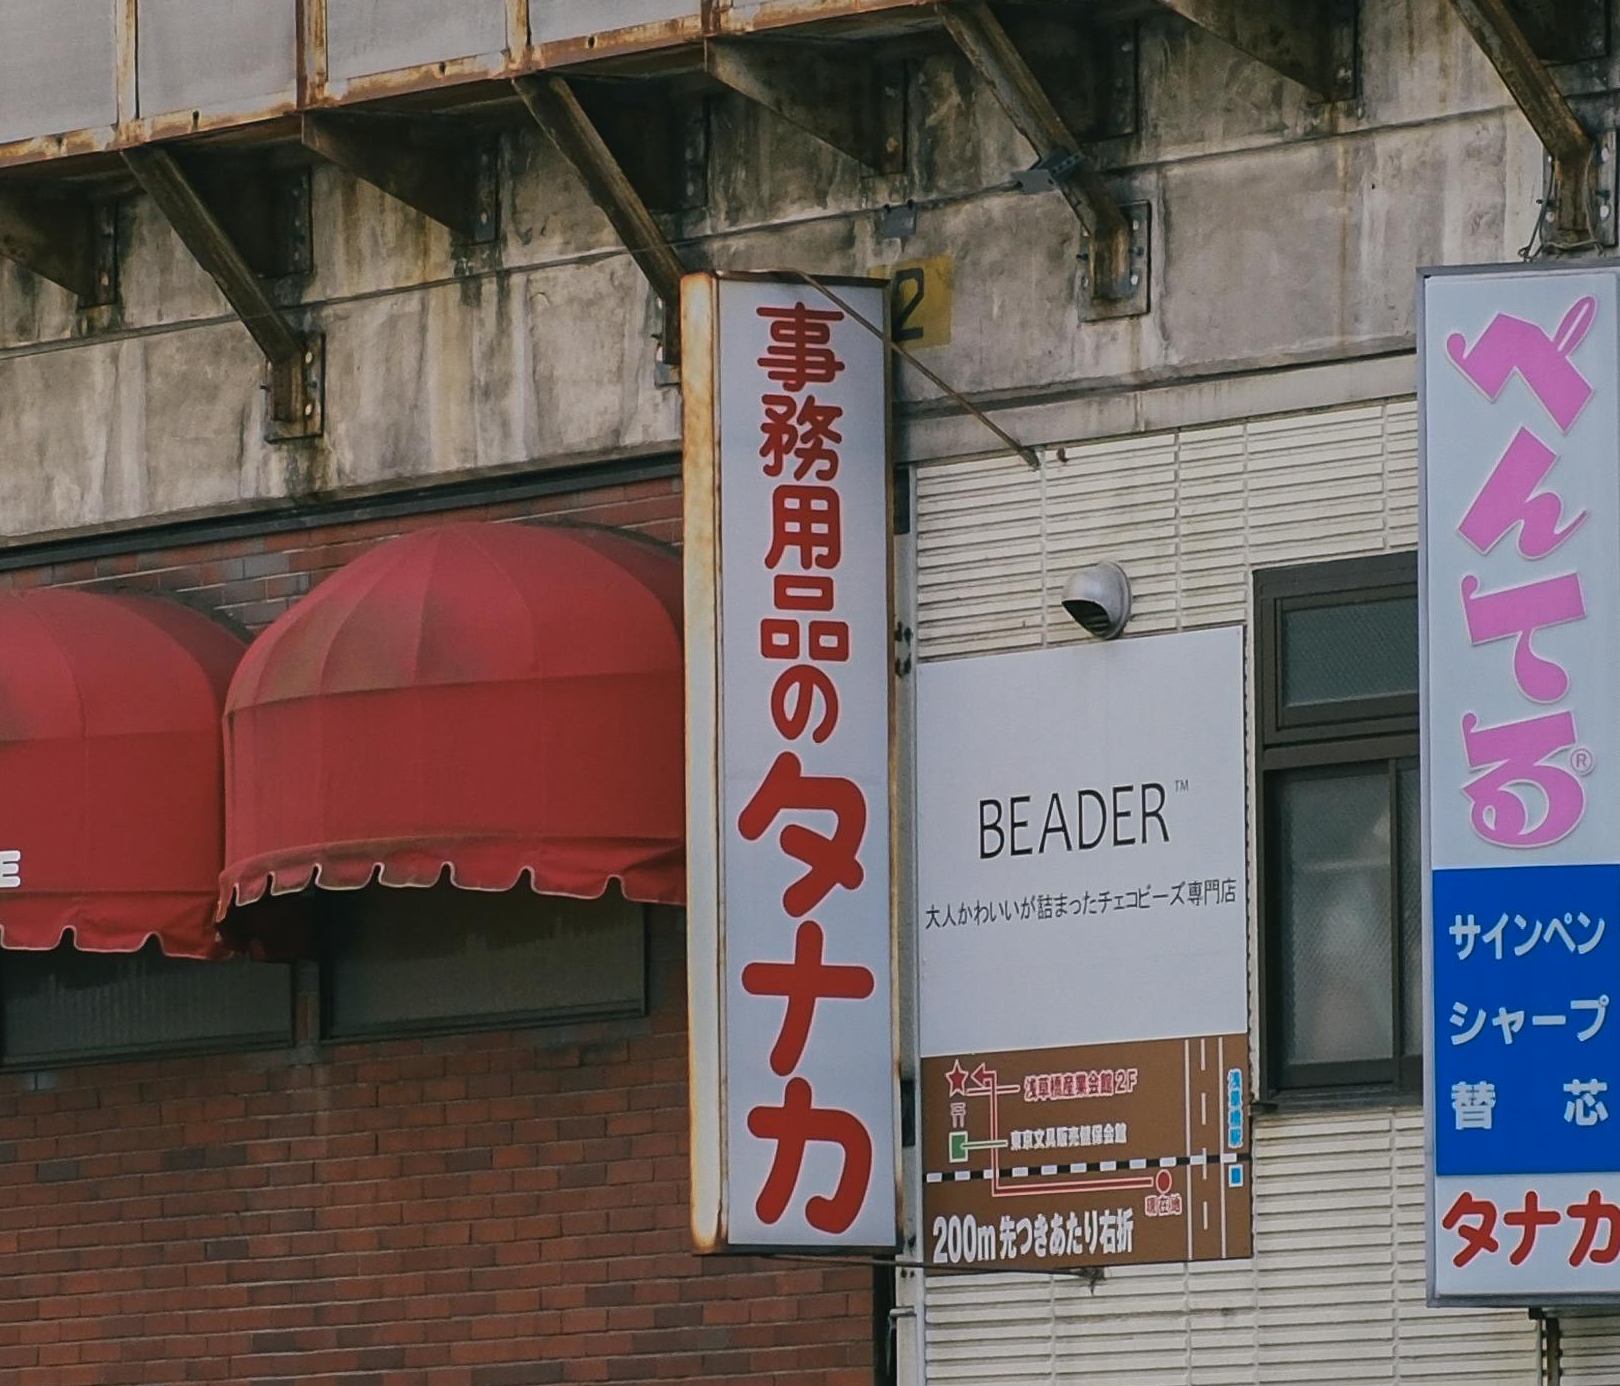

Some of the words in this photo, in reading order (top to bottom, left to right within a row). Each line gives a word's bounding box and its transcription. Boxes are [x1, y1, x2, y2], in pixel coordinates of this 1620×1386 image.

[736, 300, 876, 1237] 事務用品のタナカ
[980, 781, 1170, 859] BEADER
[925, 877, 1237, 931] 大人かわいいが詰まったチェコビーズ専門店
[1448, 911, 1606, 959] サインペン
[1450, 995, 1611, 1045] シャープ
